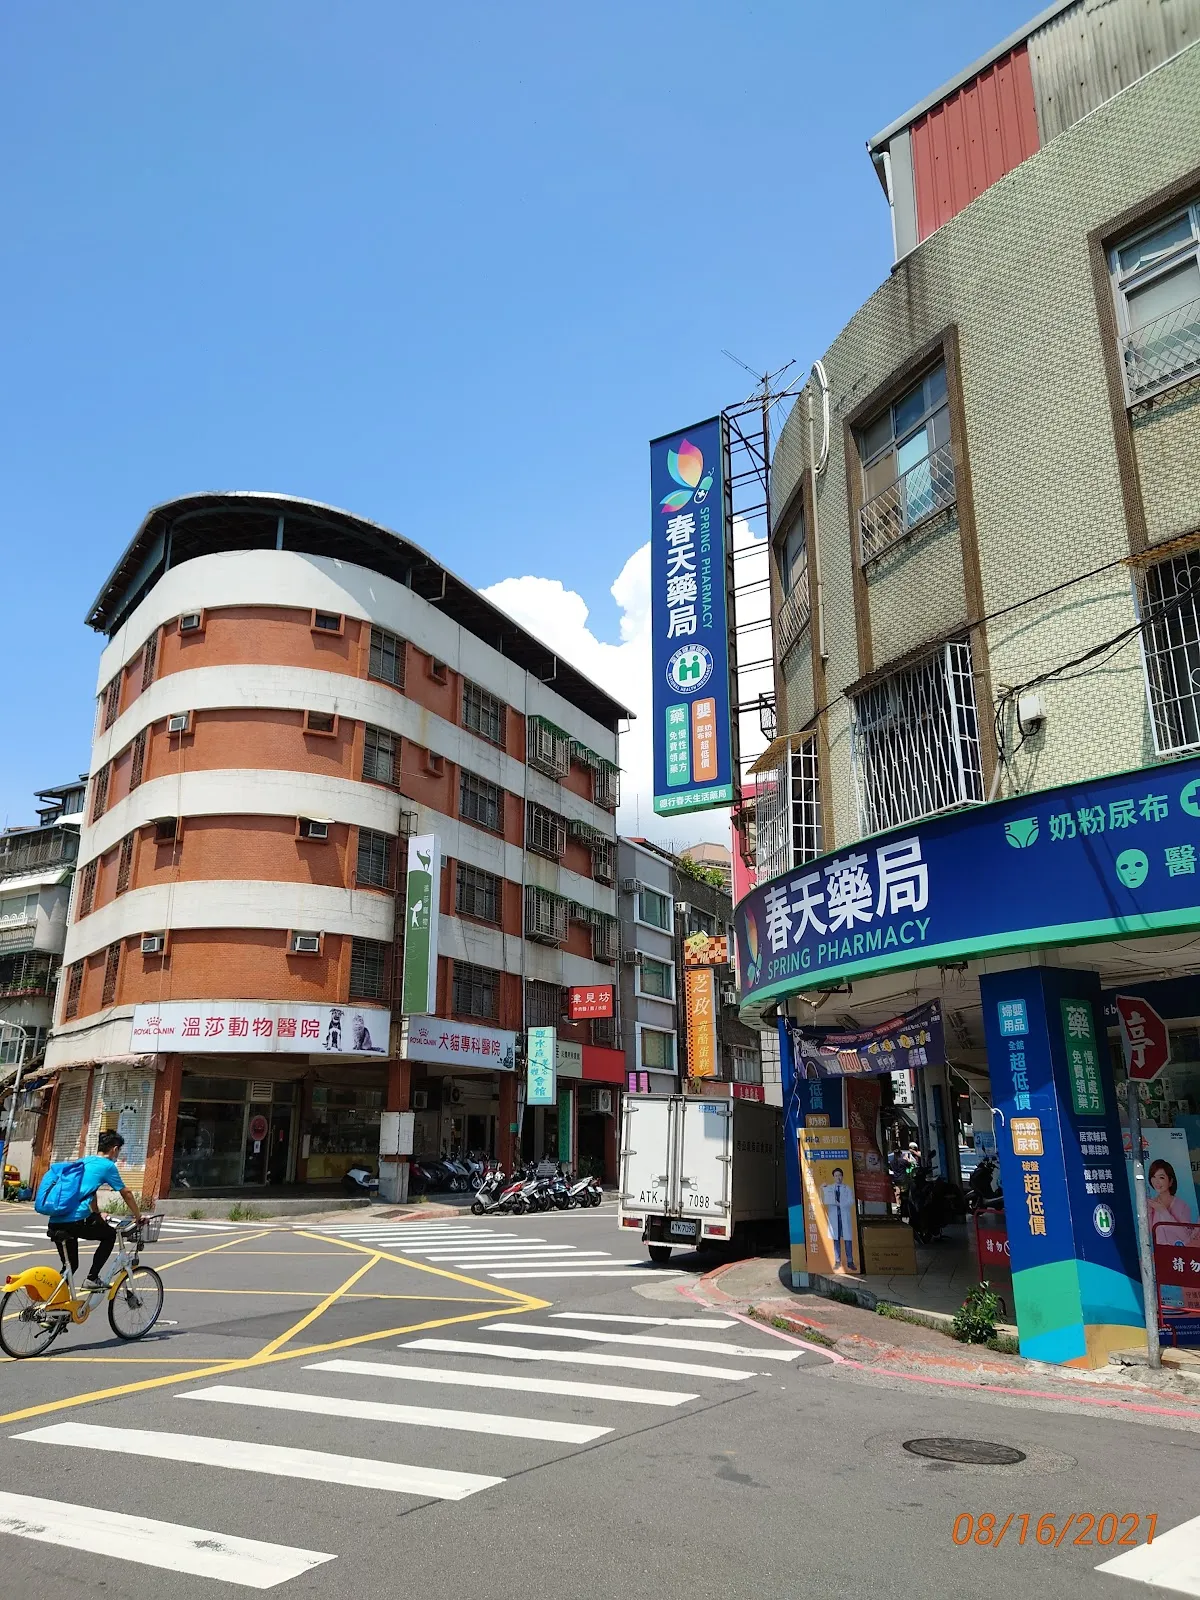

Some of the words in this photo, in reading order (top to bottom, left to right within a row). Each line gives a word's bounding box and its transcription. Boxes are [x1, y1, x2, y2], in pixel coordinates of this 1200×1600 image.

[700, 506, 710, 553] SPRING
[666, 512, 698, 639] 春天藥局
[701, 557, 713, 629] PHARMACY
[670, 708, 684, 725] 藥
[700, 740, 710, 768] 超低價
[1049, 794, 1169, 842] 奶粉尿布
[764, 835, 929, 954] 春天藥局
[767, 948, 811, 980] SPRING
[818, 917, 931, 964] PHARMACY
[693, 974, 711, 1016] 芝玫
[153, 1027, 175, 1035] CANIN
[181, 1017, 320, 1038] 溫莎動物醫院
[1004, 1019, 1025, 1032] 用品
[1066, 1005, 1090, 1039] 藥
[439, 1033, 501, 1057] 犬貓專科醫院
[899, 1073, 908, 1103] 日本料理
[1009, 1052, 1032, 1111] 超低價
[1072, 1050, 1089, 1109] 免費領藥
[1083, 1050, 1100, 1109] 慢性處方
[1015, 1123, 1037, 1135] 奶粉
[1017, 1138, 1039, 1151] 尿布
[689, 1194, 710, 1209] 7098
[1024, 1174, 1047, 1236] 超低價
